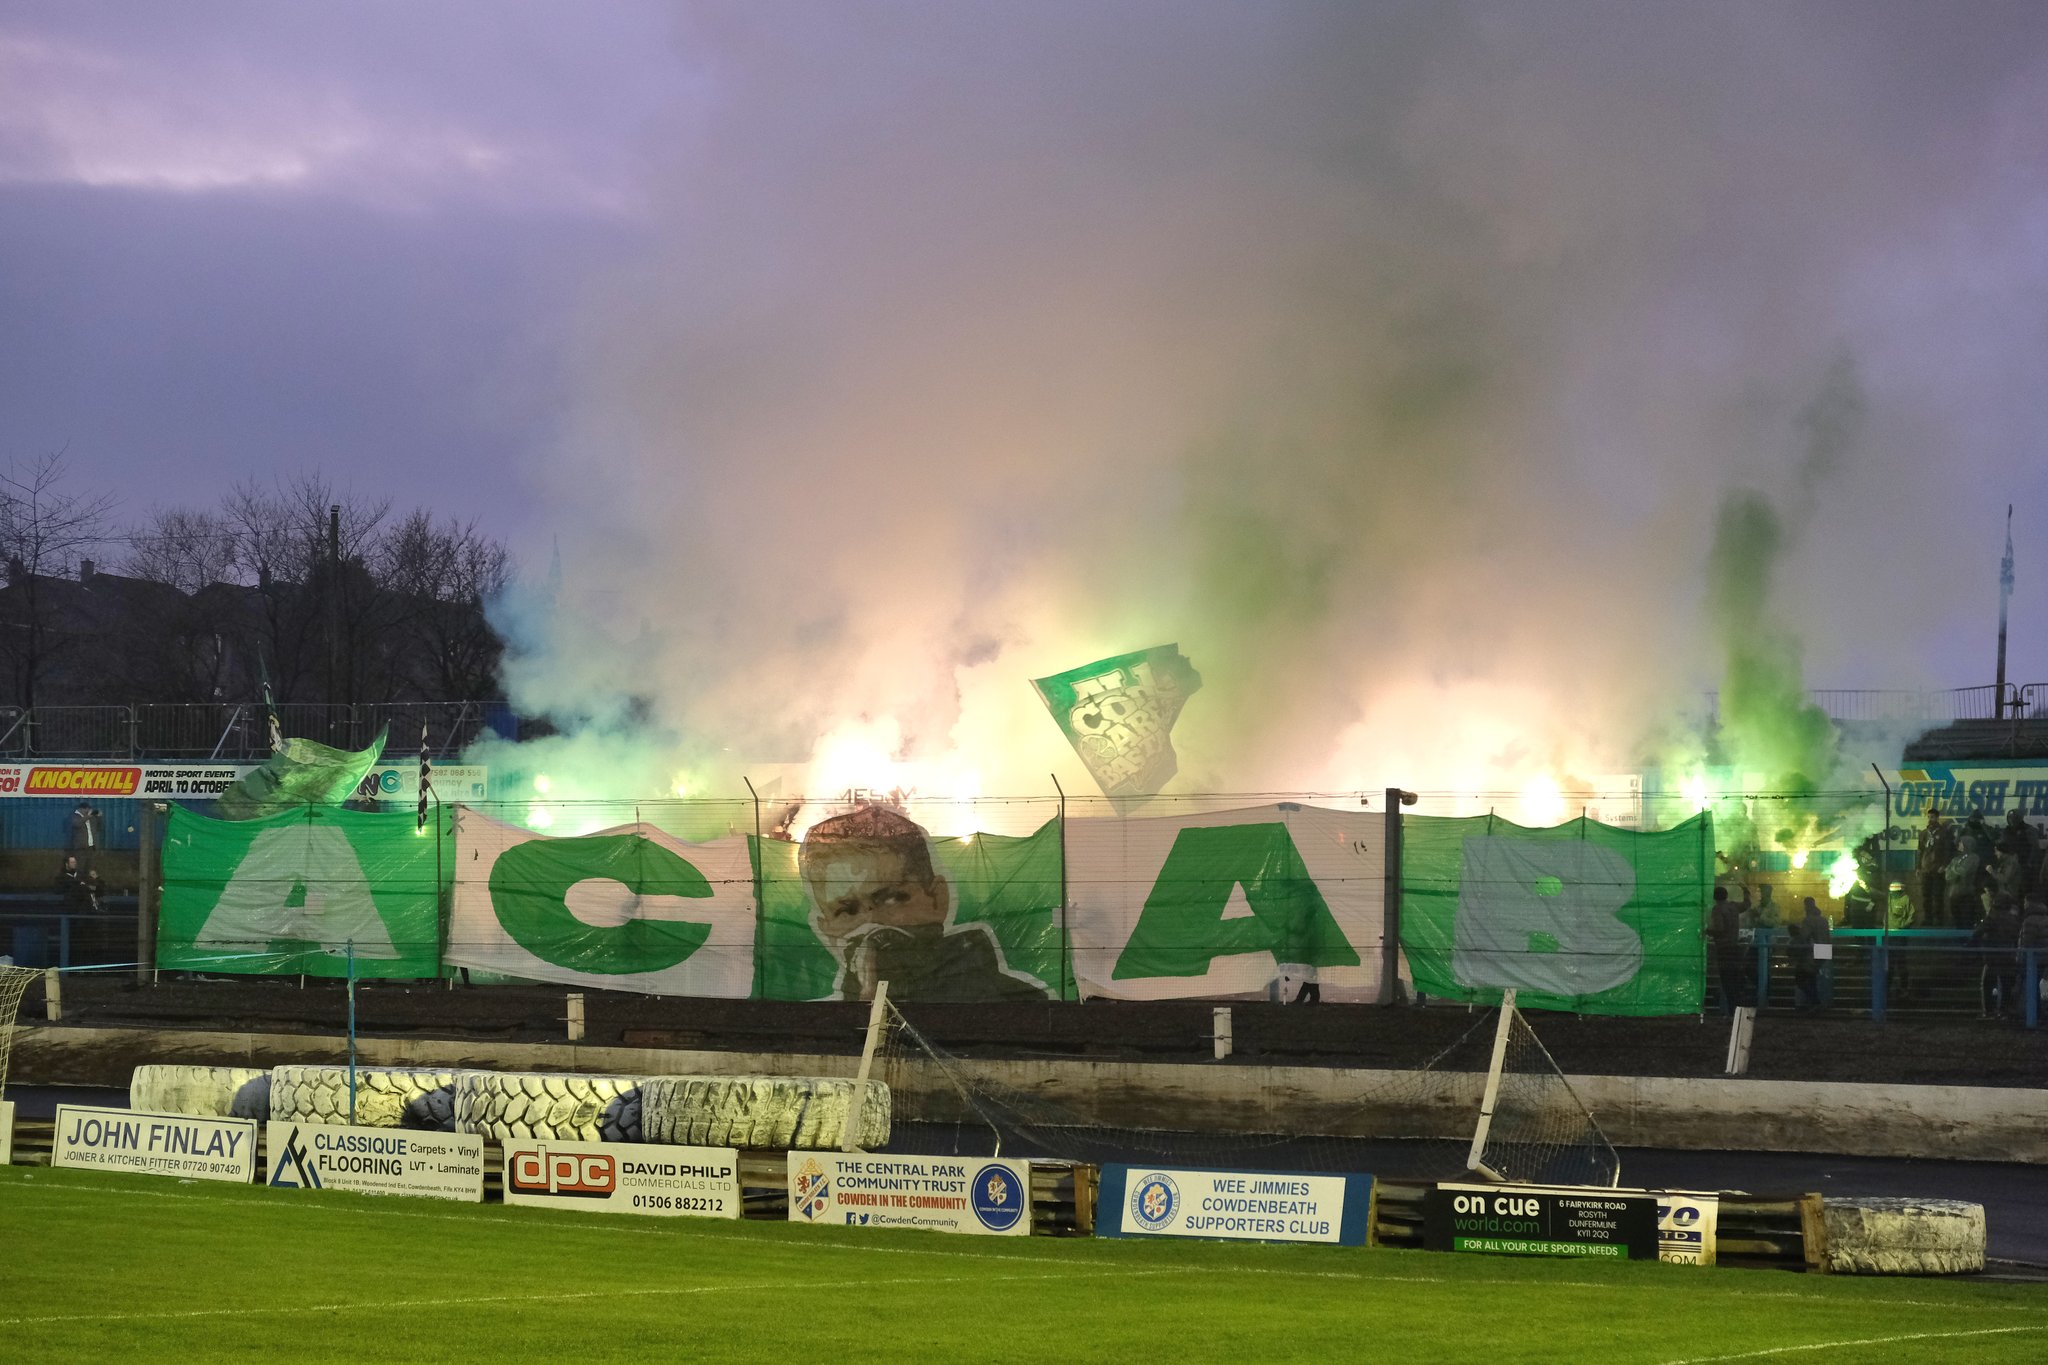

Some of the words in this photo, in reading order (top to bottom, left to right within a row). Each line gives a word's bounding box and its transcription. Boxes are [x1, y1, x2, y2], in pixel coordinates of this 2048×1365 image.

[30, 770, 134, 790] KNOCKHILL
[144, 770, 174, 778] MOTOR
[175, 770, 203, 778] SPORT
[204, 770, 236, 778] EVENTS
[357, 769, 418, 796] NCE
[144, 780, 173, 793] APRIL
[176, 780, 188, 793] TO
[190, 780, 235, 793] OCTOBE
[191, 826, 397, 960] A
[490, 837, 713, 974] C
[1112, 824, 1362, 981] A
[1452, 834, 1644, 991] B
[67, 1118, 140, 1150] JOHN
[148, 1124, 243, 1158] FINLAY
[314, 1134, 407, 1156] CLASSIQUE
[410, 1142, 446, 1156] Carpets
[458, 1146, 480, 1159] Vinyl
[64, 1150, 97, 1162] JOINER
[99, 1154, 105, 1163] &
[108, 1154, 147, 1166] KITCHEN
[149, 1158, 180, 1170] FITTER
[182, 1160, 208, 1172] 07720
[210, 1163, 240, 1175] 907420
[319, 1155, 402, 1176] FLOORING
[410, 1161, 426, 1172] LVT
[438, 1163, 480, 1175] Laminate
[516, 1144, 611, 1193] dpc
[622, 1162, 676, 1176] DAVID
[680, 1164, 732, 1178] PHILP
[836, 1162, 862, 1174] THE
[864, 1162, 928, 1177] CENTRAL
[932, 1166, 966, 1178] PARK
[622, 1177, 705, 1190] COMMERCIALS
[709, 1181, 731, 1192] LTD
[836, 1176, 924, 1191] COMMUNITY
[922, 1180, 966, 1192] TRUST
[1213, 1179, 1245, 1194] WEE
[1250, 1181, 1310, 1196] JIMMIES
[632, 1194, 671, 1209] 01506
[675, 1196, 723, 1212] 882212
[837, 1192, 878, 1207] COWDEN
[878, 1194, 888, 1207] IN
[892, 1194, 908, 1208] THE
[908, 1196, 966, 1210] COMMUNITY
[1202, 1198, 1316, 1215] COWDENBEATH
[1454, 1195, 1486, 1215] on
[1494, 1198, 1540, 1216] cue
[1559, 1200, 1565, 1209] 6
[1566, 1200, 1604, 1210] FAIRYKIRK
[1606, 1202, 1627, 1210] ROAD
[871, 1214, 959, 1230] @CowdenCommunity
[1578, 1210, 1608, 1219] ROSYTH
[1186, 1216, 1285, 1234] SUPPORTERS
[1290, 1220, 1330, 1234] CLUB
[1454, 1216, 1540, 1233] world.com
[1568, 1220, 1617, 1230] DUNFERMLINE
[1658, 1231, 1697, 1241] TD.
[1464, 1240, 1483, 1250] FOR
[1484, 1241, 1500, 1250] ALL
[1500, 1242, 1528, 1252] YOUR
[1530, 1243, 1549, 1253] CUE
[1551, 1244, 1587, 1254] SPORTS
[1588, 1246, 1618, 1256] NEEDS
